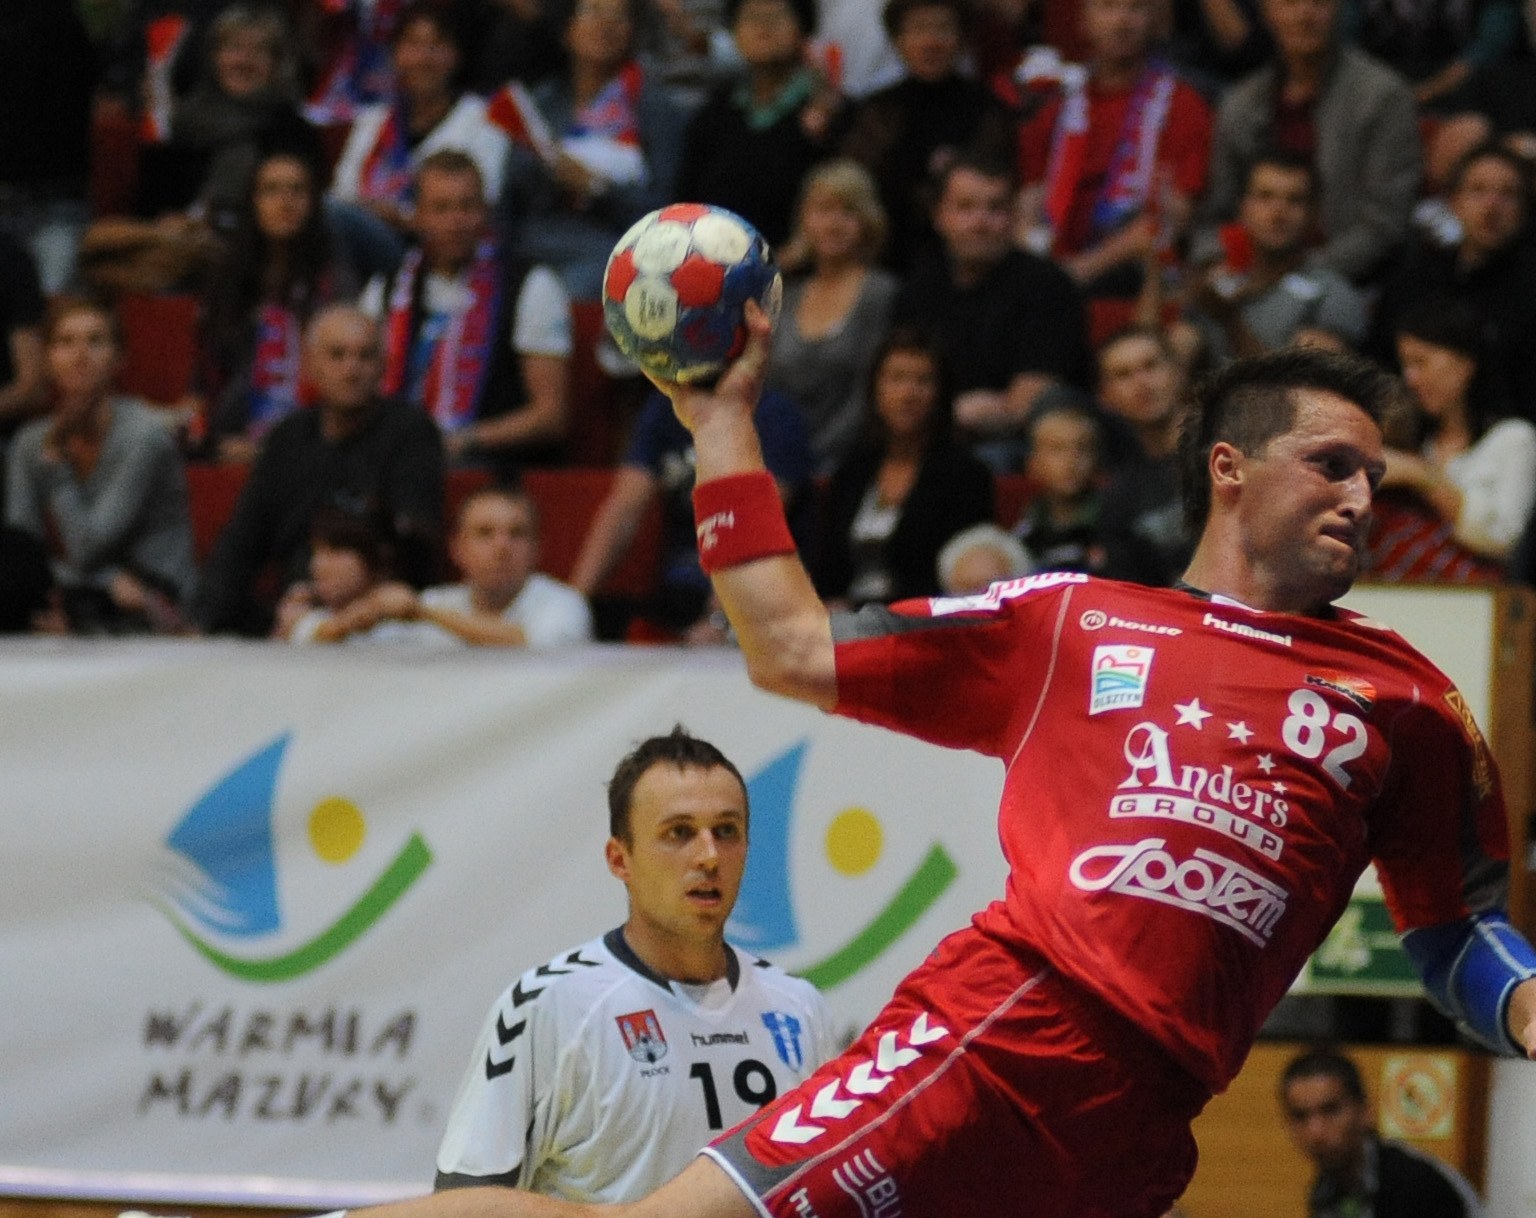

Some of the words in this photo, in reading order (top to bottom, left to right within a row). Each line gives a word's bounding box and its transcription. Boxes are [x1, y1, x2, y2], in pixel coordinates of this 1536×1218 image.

[1202, 611, 1293, 649] hummel
[1281, 688, 1369, 792] 82
[1116, 720, 1290, 829] Anders
[1116, 797, 1279, 853] GROUP
[141, 1002, 418, 1060] WARMIA
[689, 1030, 750, 1048] hummel
[688, 1058, 777, 1131] 19
